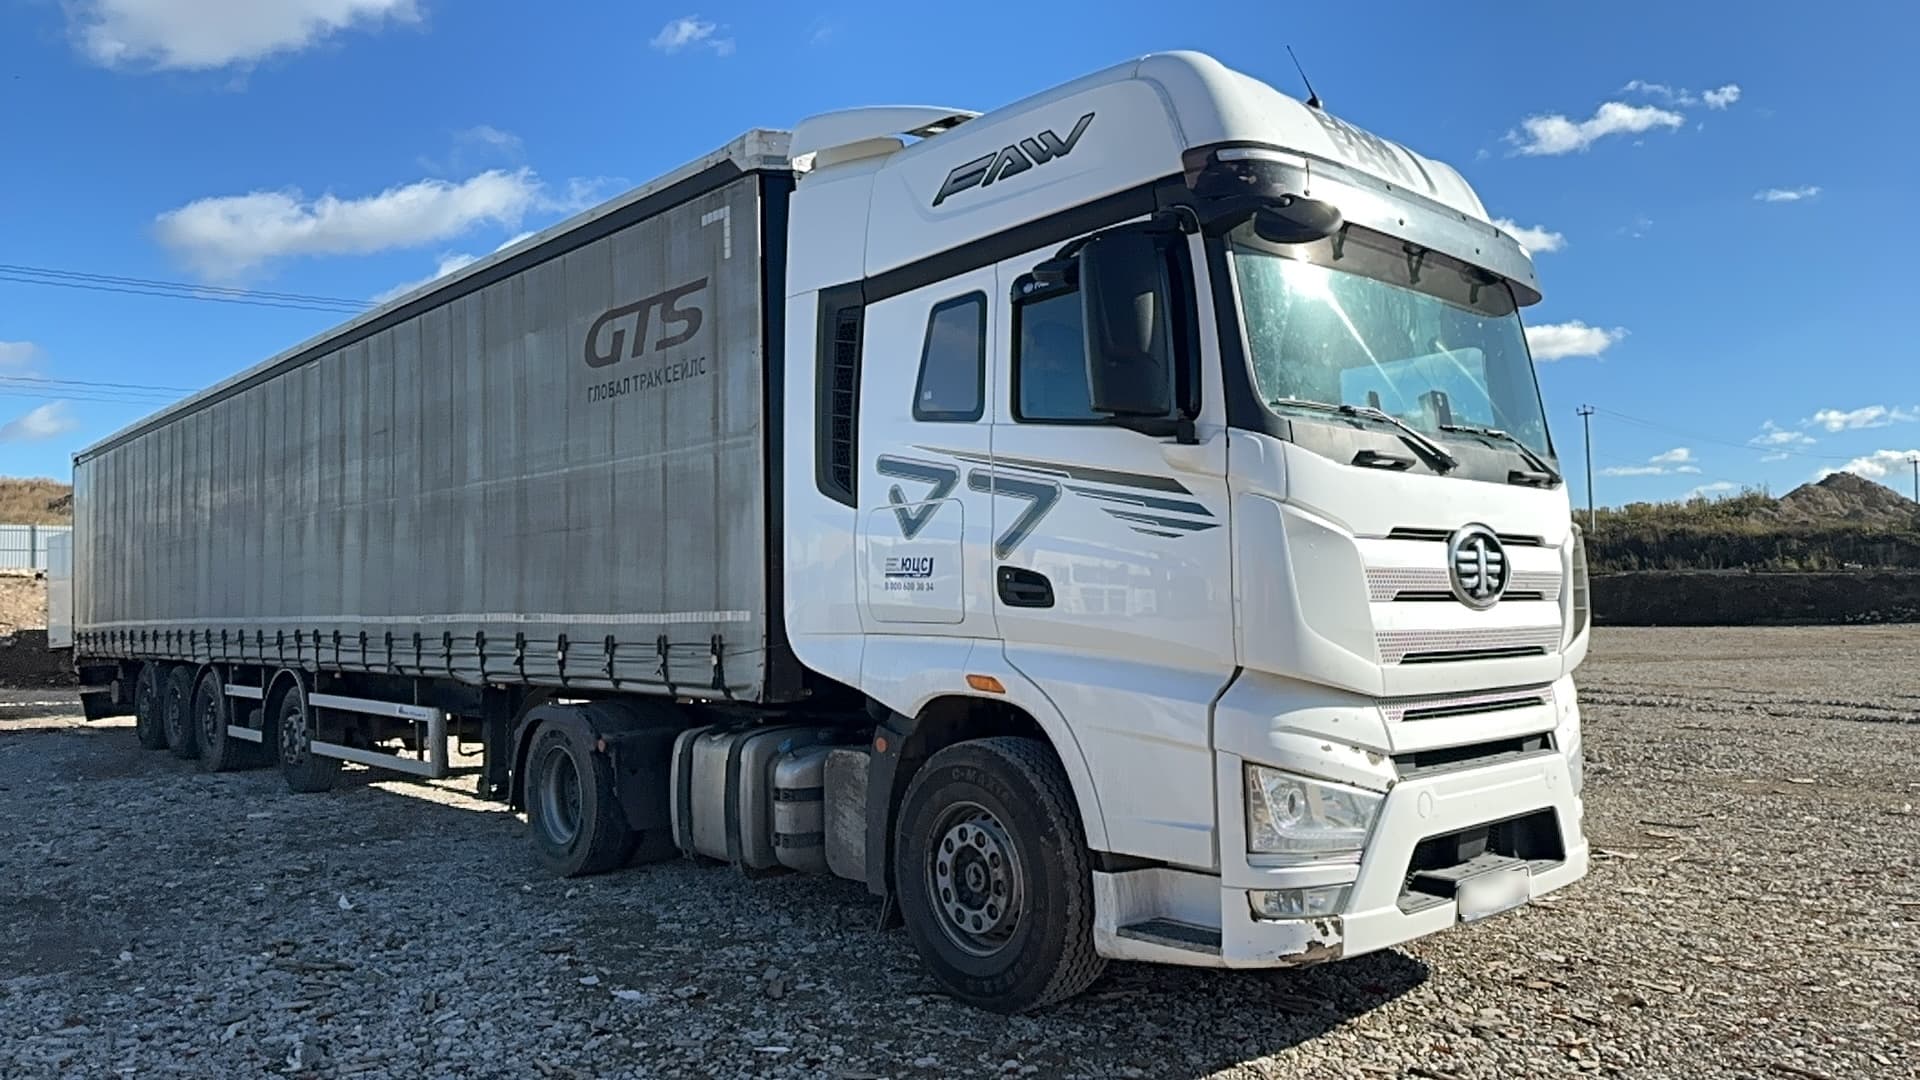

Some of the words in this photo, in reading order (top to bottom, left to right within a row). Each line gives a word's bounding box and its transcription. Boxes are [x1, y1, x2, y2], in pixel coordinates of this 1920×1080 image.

[932, 112, 1096, 207] FAW
[584, 276, 709, 369] GTS
[587, 377, 630, 404] ГЛОБАЛ
[634, 370, 663, 392] ТРАК
[664, 356, 706, 383] СЕЙЛС
